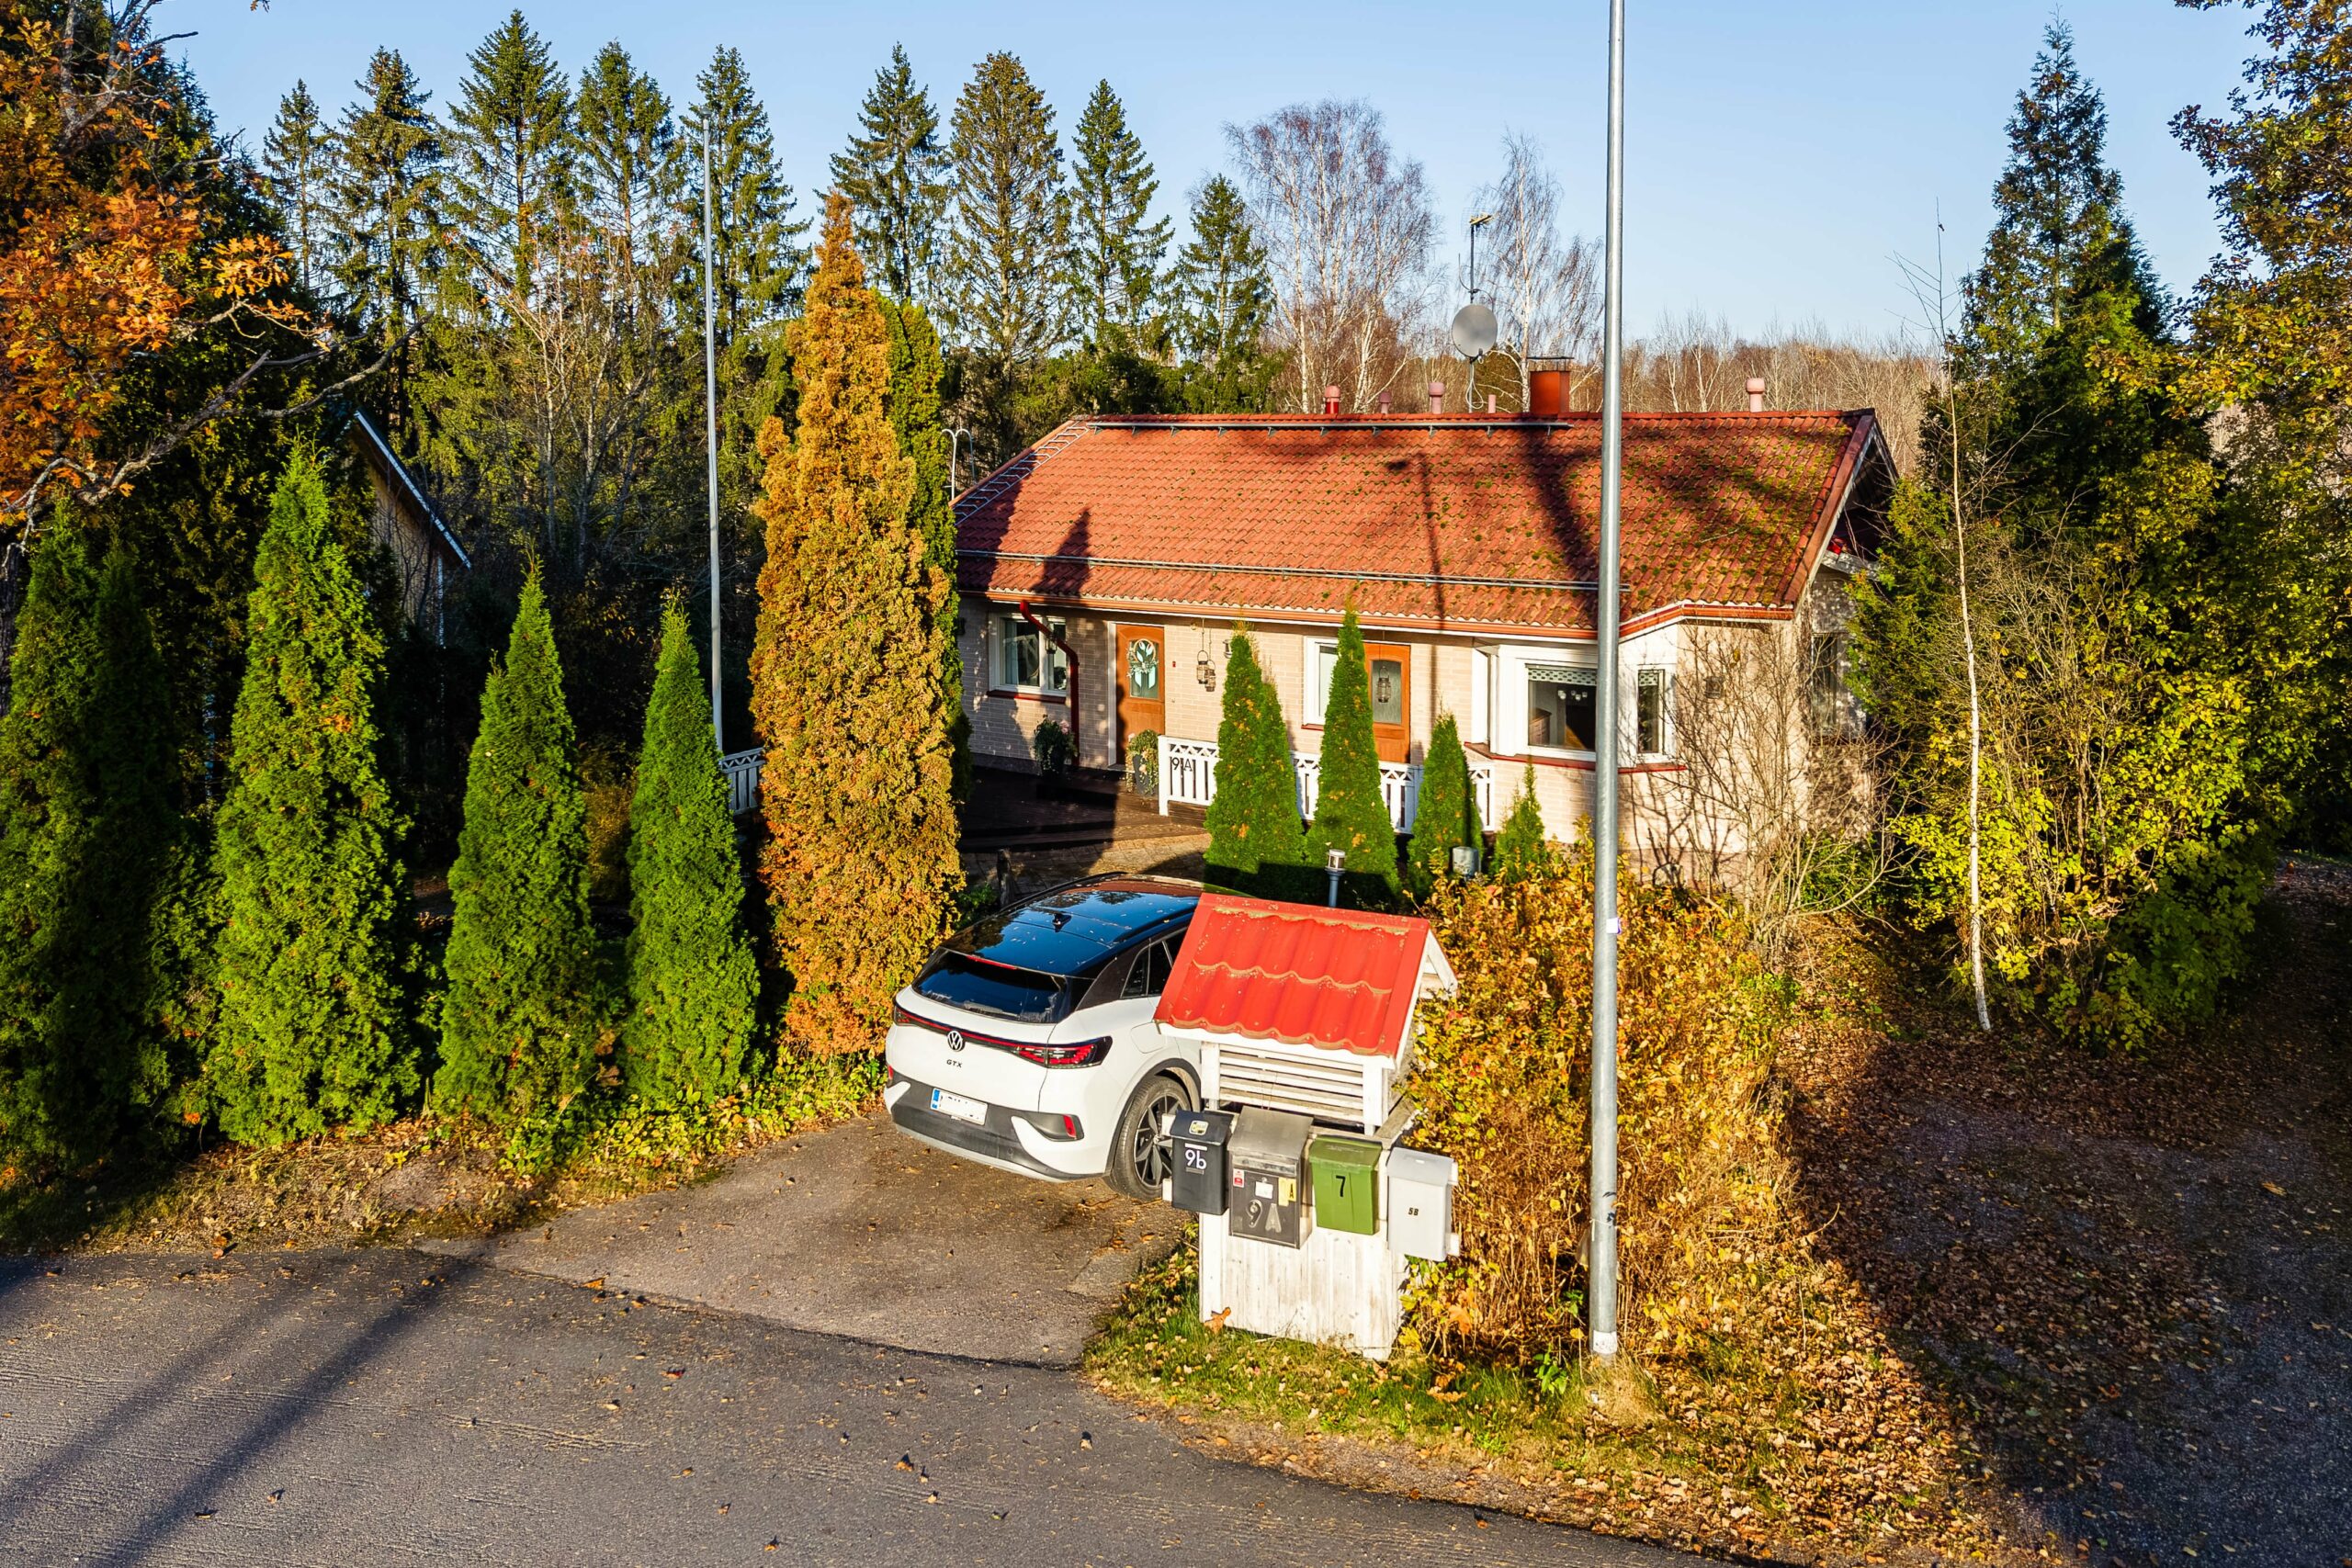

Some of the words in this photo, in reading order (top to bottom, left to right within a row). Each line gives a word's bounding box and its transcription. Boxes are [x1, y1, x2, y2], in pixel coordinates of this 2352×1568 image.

[946, 1059, 962, 1068] GTX
[1185, 1149, 1207, 1169] 9b
[1335, 1175, 1346, 1198] 7
